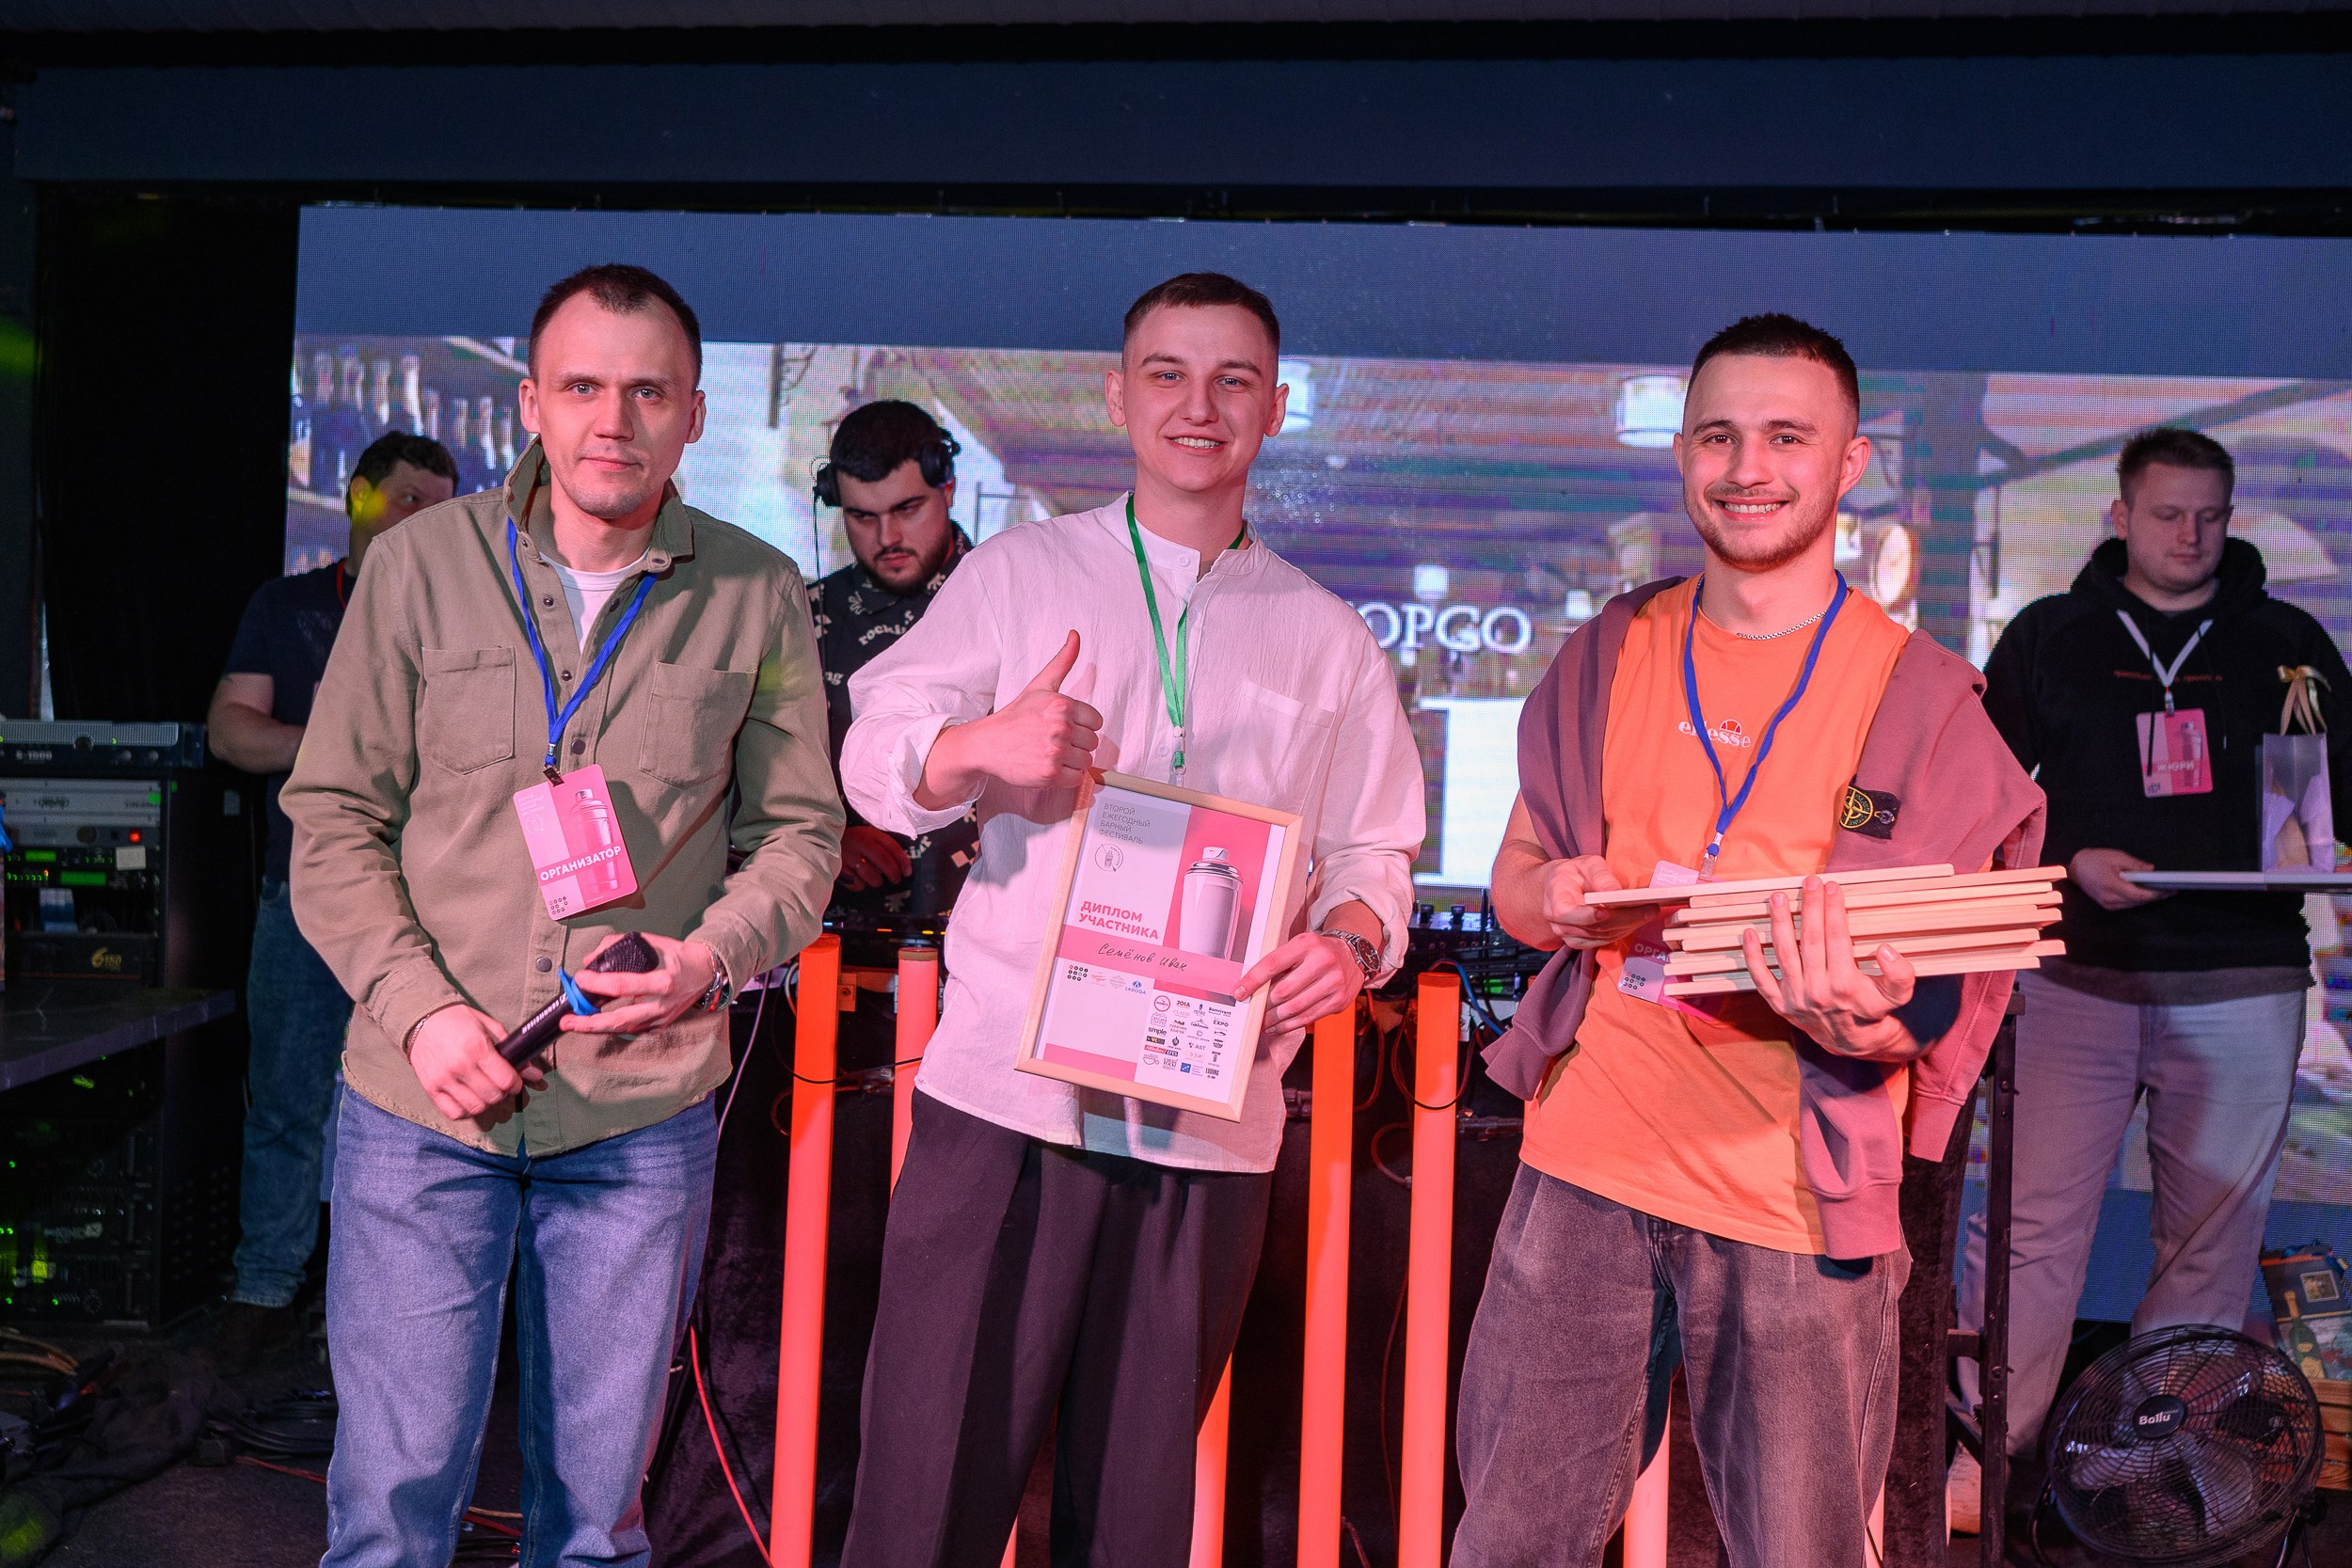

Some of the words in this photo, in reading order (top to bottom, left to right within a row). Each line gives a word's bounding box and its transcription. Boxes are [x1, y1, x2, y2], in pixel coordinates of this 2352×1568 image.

[1104, 803, 1136, 816] ВТОРОЙ
[1100, 820, 1132, 832] БАРНЫЙ
[1102, 812, 1151, 828] ЕЖЕГОДНЫЙ
[1098, 829, 1144, 845] ФЕСТИВАЛЬ
[540, 846, 621, 881] ОРГАНИЗАТОР
[1080, 900, 1143, 923] ДИПЛОМ
[1078, 912, 1159, 940] УЧАСТНИКА
[1098, 942, 1156, 963] Семёнов
[1125, 987, 1147, 995] LADOGA
[1148, 1026, 1168, 1036] simple
[2138, 1411, 2170, 1425] Ballu
